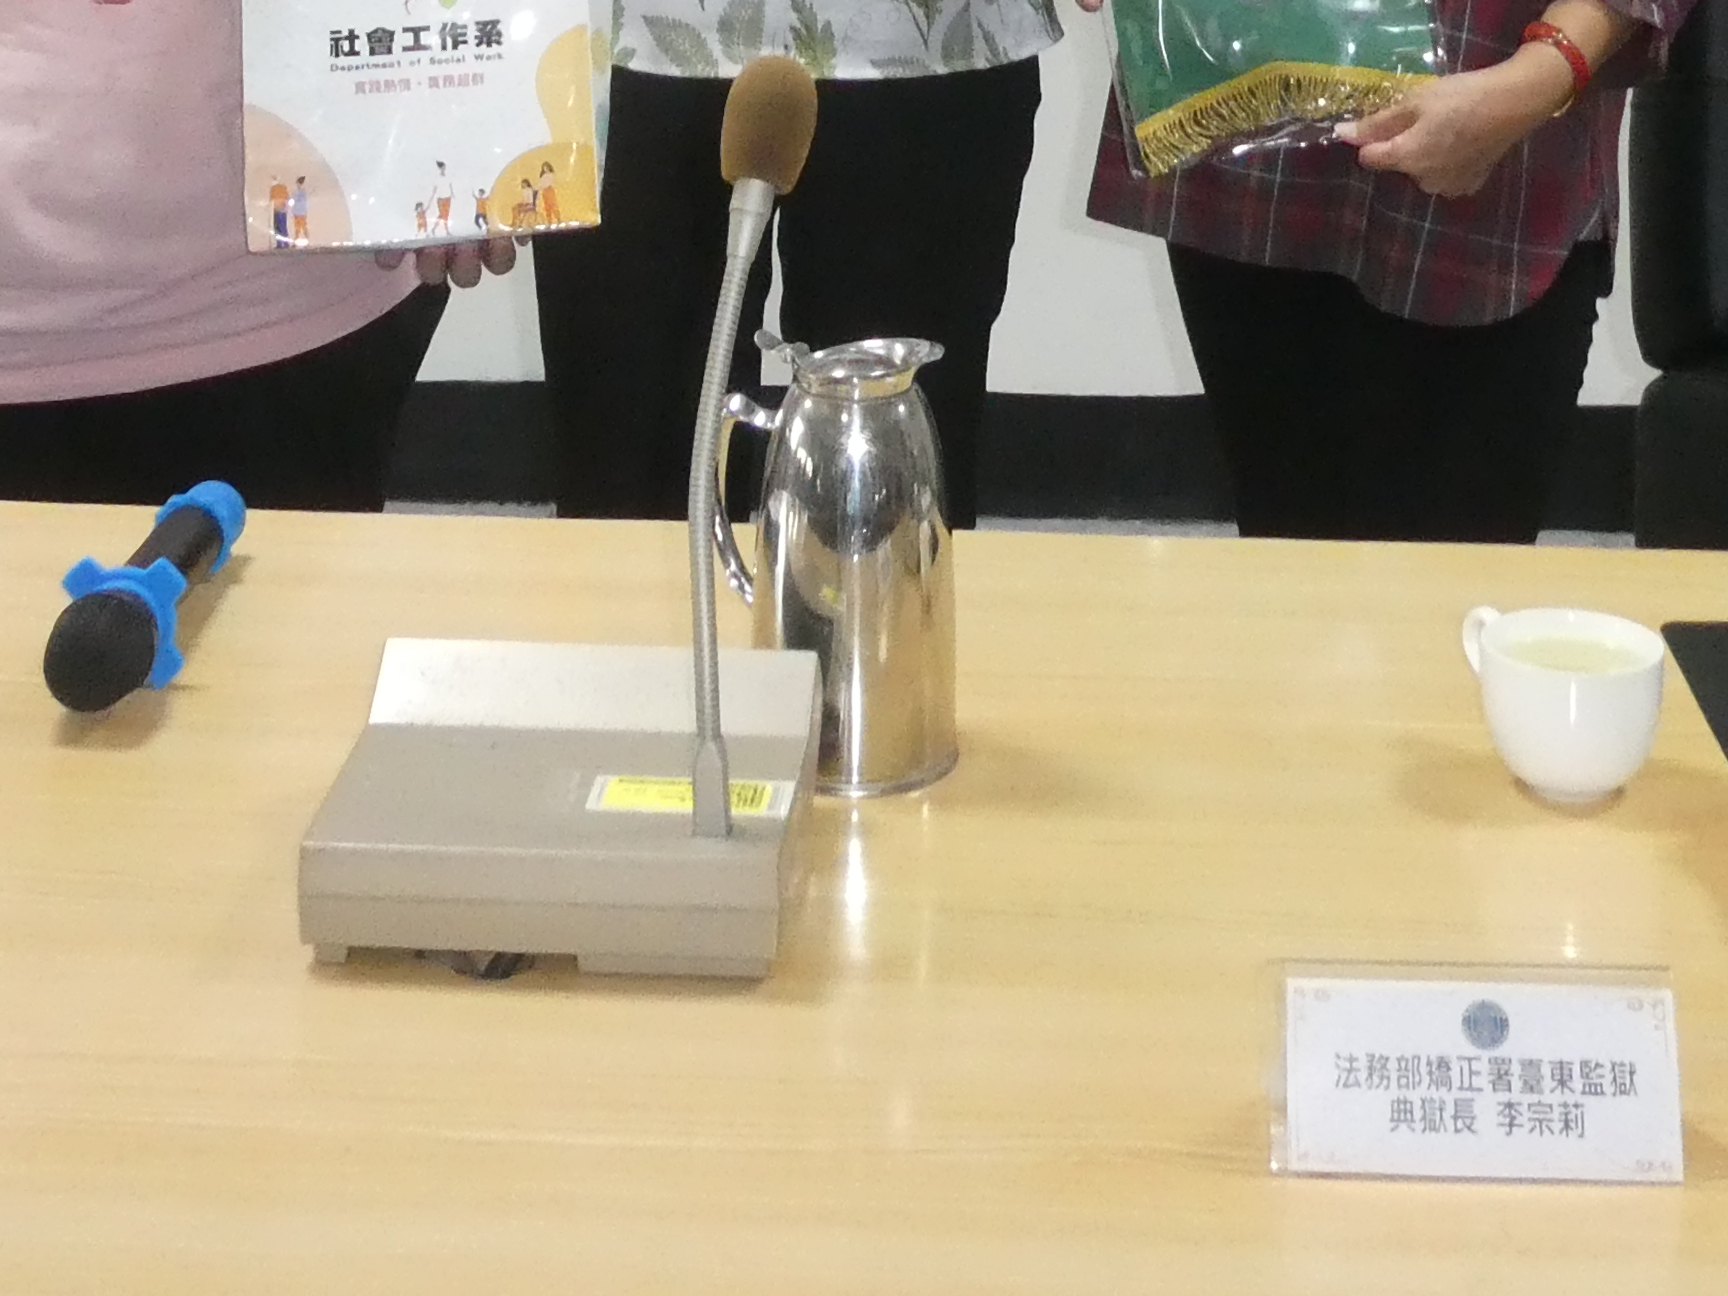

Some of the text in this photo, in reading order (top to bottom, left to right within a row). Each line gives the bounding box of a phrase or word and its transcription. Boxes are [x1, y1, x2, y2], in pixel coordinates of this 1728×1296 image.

[329, 19, 503, 58] 社會工作系
[329, 52, 505, 73] Department of Social Work
[1334, 1052, 1639, 1098] 法務部矯正署臺東監獄
[1389, 1096, 1587, 1139] 典獄長 李宗莉
